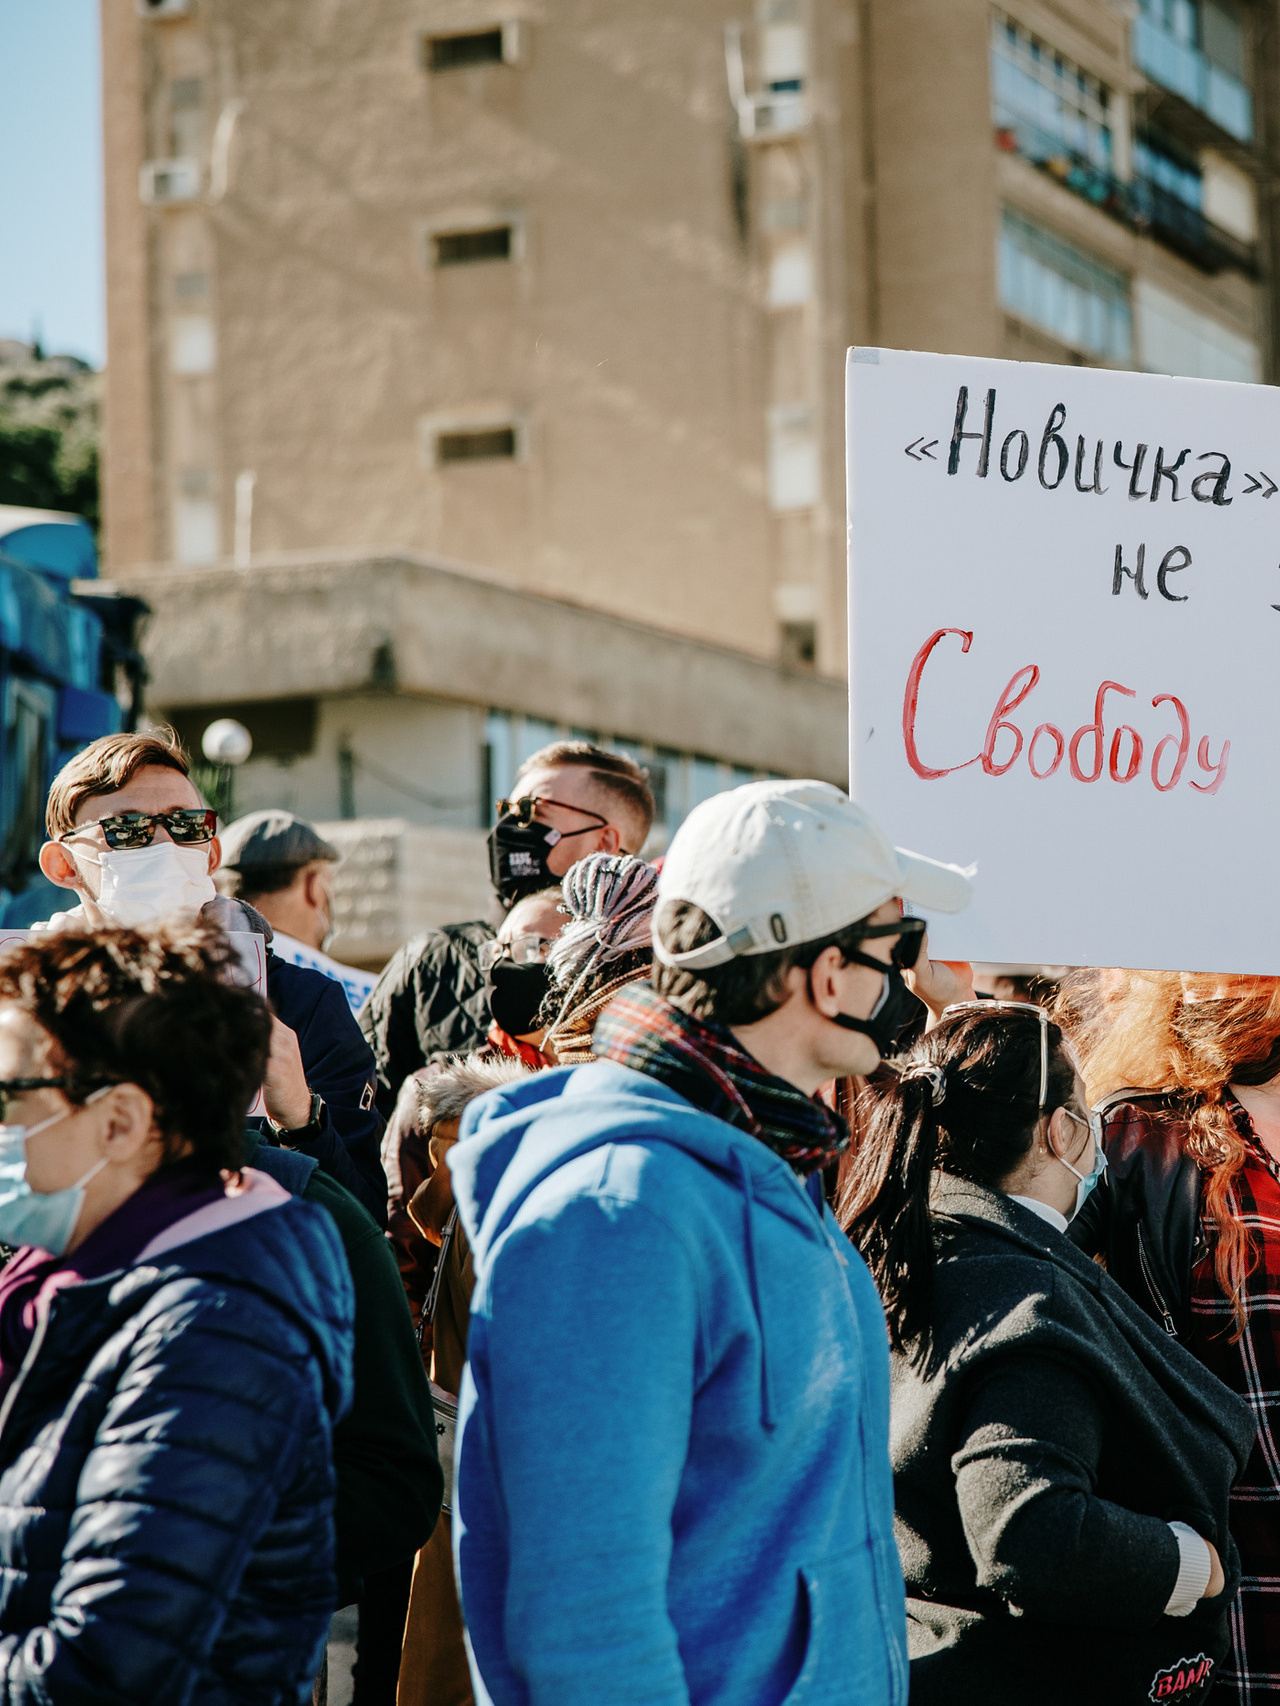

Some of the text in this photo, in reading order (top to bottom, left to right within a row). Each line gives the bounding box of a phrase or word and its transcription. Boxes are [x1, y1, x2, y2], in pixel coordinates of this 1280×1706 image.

[904, 385, 1279, 506] «Новичка»
[1112, 543, 1193, 602] не
[902, 627, 1231, 796] Свободу
